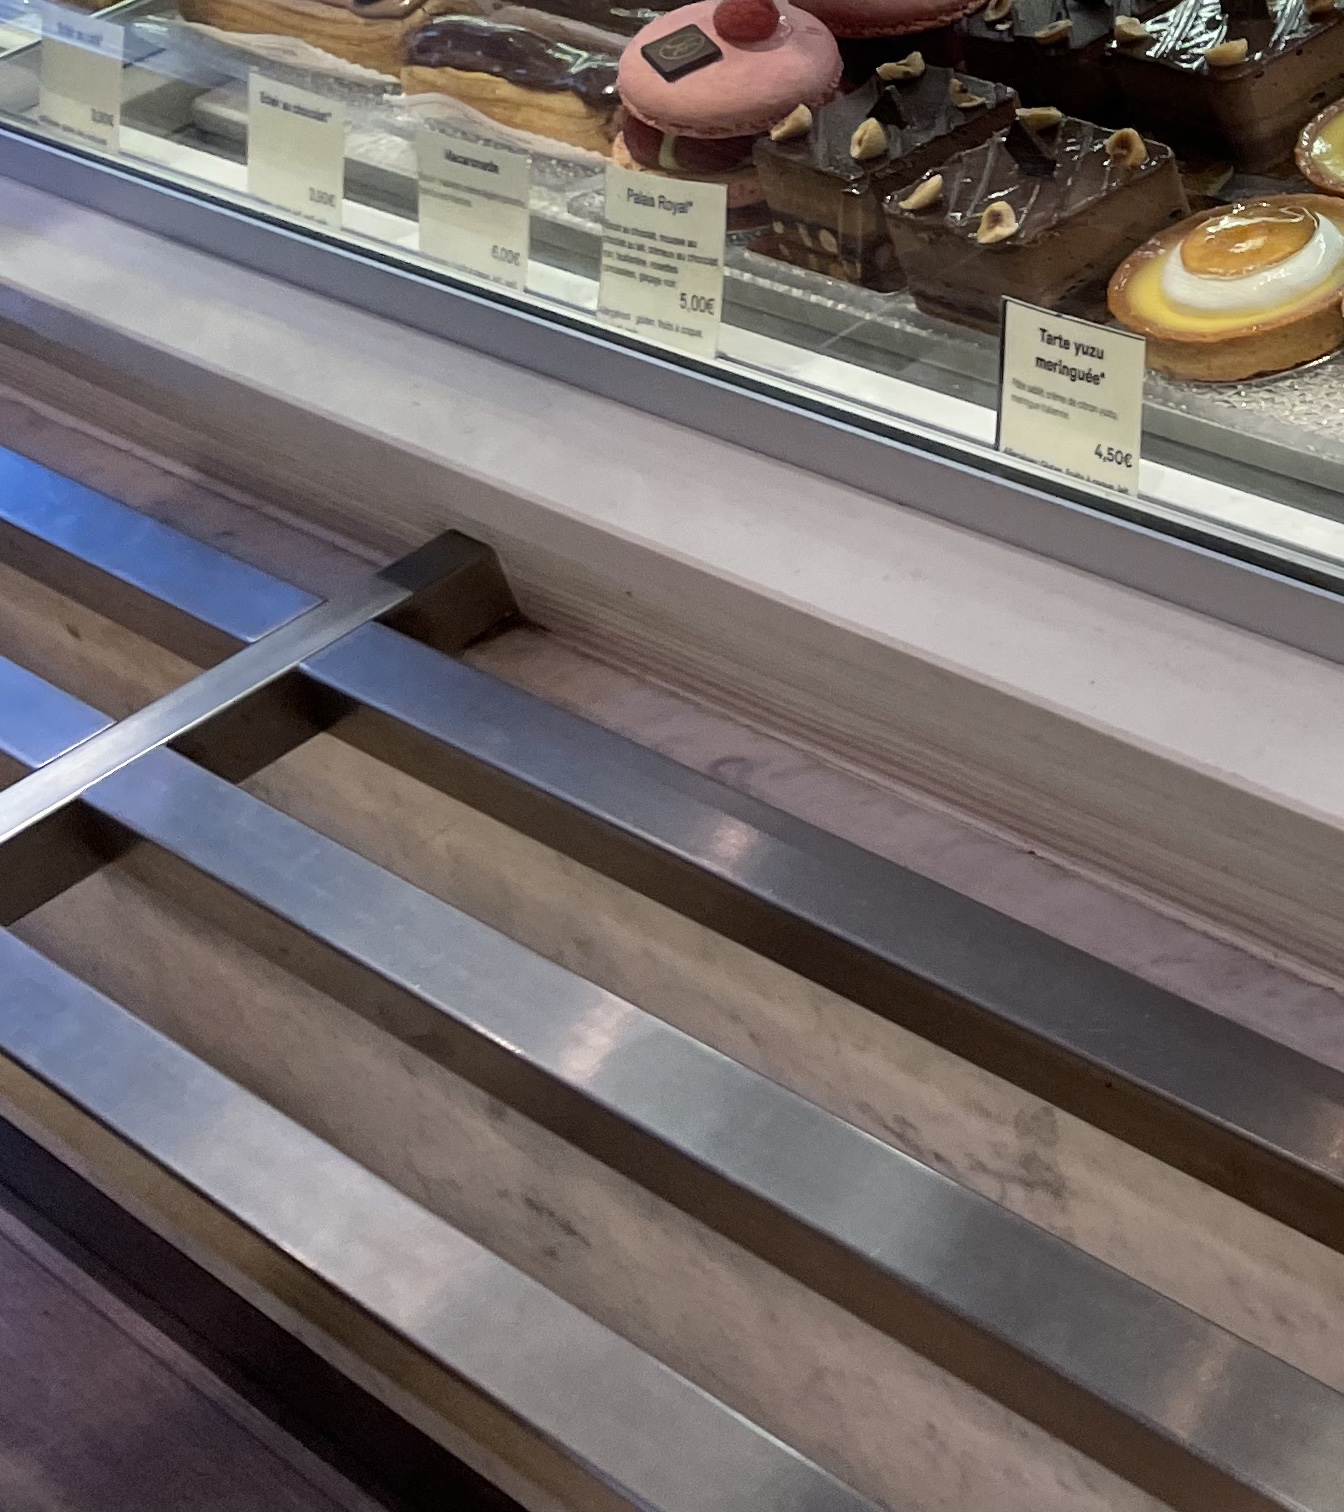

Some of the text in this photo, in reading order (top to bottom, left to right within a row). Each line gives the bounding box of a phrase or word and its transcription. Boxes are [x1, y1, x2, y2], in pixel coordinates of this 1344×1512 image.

[680, 292, 717, 316] 5,00€
[1039, 327, 1105, 360] Tarte yuzu
[1094, 443, 1133, 469] 4,50€
